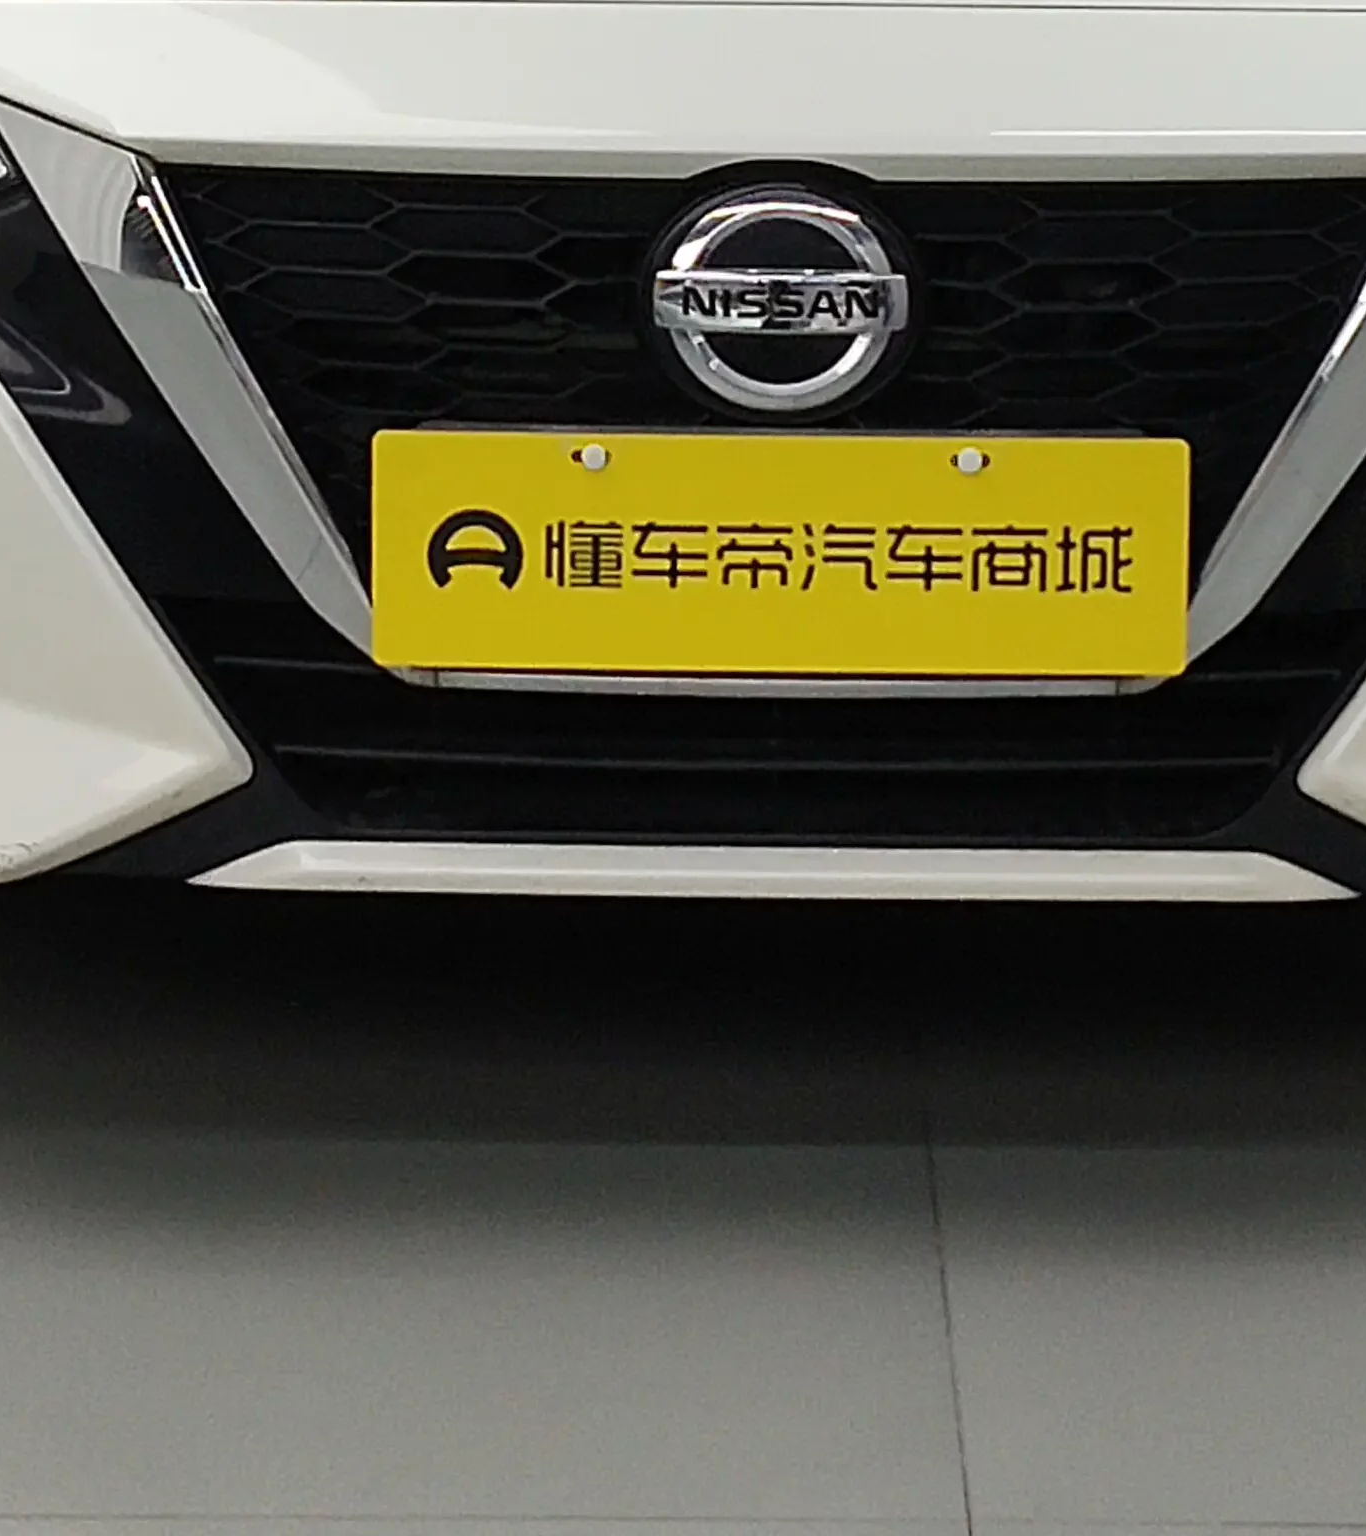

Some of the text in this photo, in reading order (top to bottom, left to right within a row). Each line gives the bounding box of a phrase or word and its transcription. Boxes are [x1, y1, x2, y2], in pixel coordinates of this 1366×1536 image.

[681, 286, 880, 319] NISSAN
[545, 520, 1133, 593] 懂车帝汽车商城
